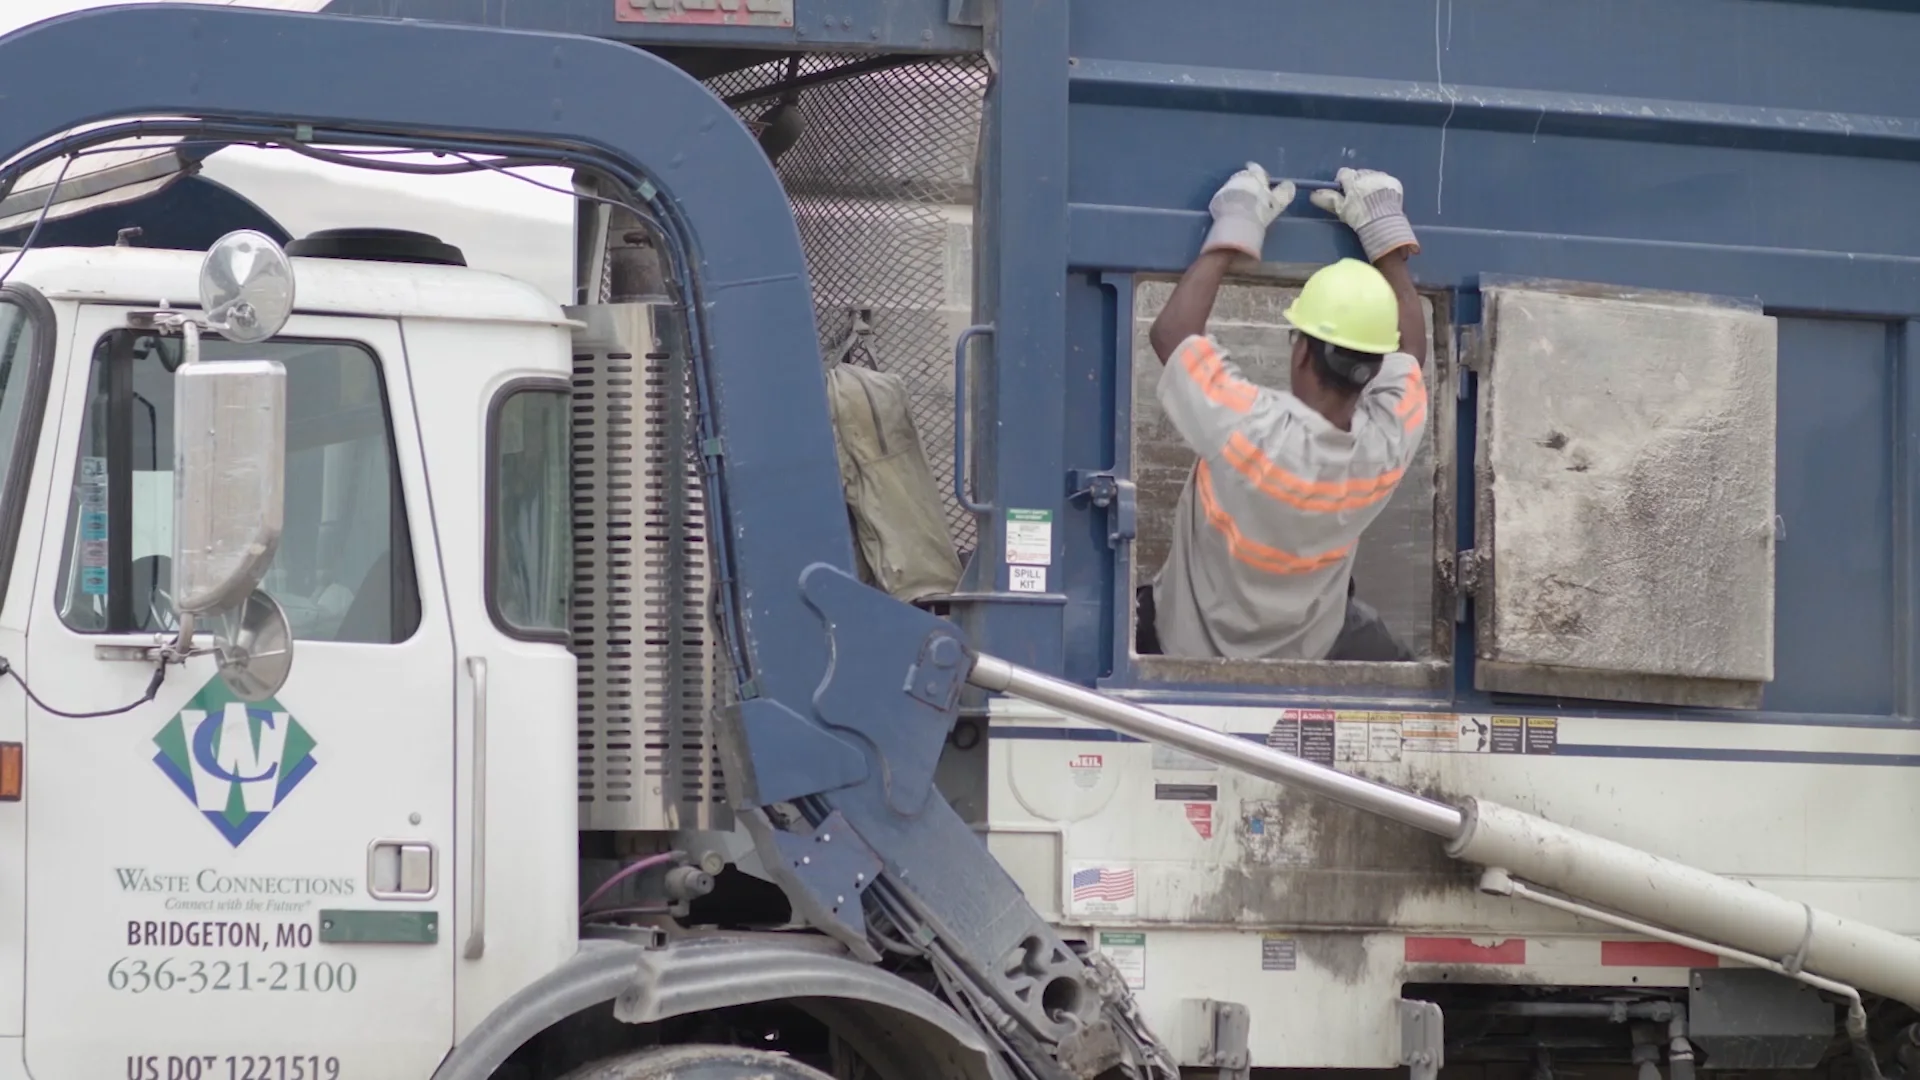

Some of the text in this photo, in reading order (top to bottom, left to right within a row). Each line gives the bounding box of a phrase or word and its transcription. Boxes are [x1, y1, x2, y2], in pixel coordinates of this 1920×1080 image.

[1014, 568, 1041, 579] SPILL
[1020, 579, 1036, 590] KIT
[164, 897, 214, 910] Connect
[217, 898, 242, 910] with
[245, 898, 262, 911] the
[127, 920, 313, 951] BRIDGETON, MO
[107, 956, 357, 993] 636-321-2100
[127, 1055, 159, 1080] US
[225, 1055, 340, 1080] 1221519
